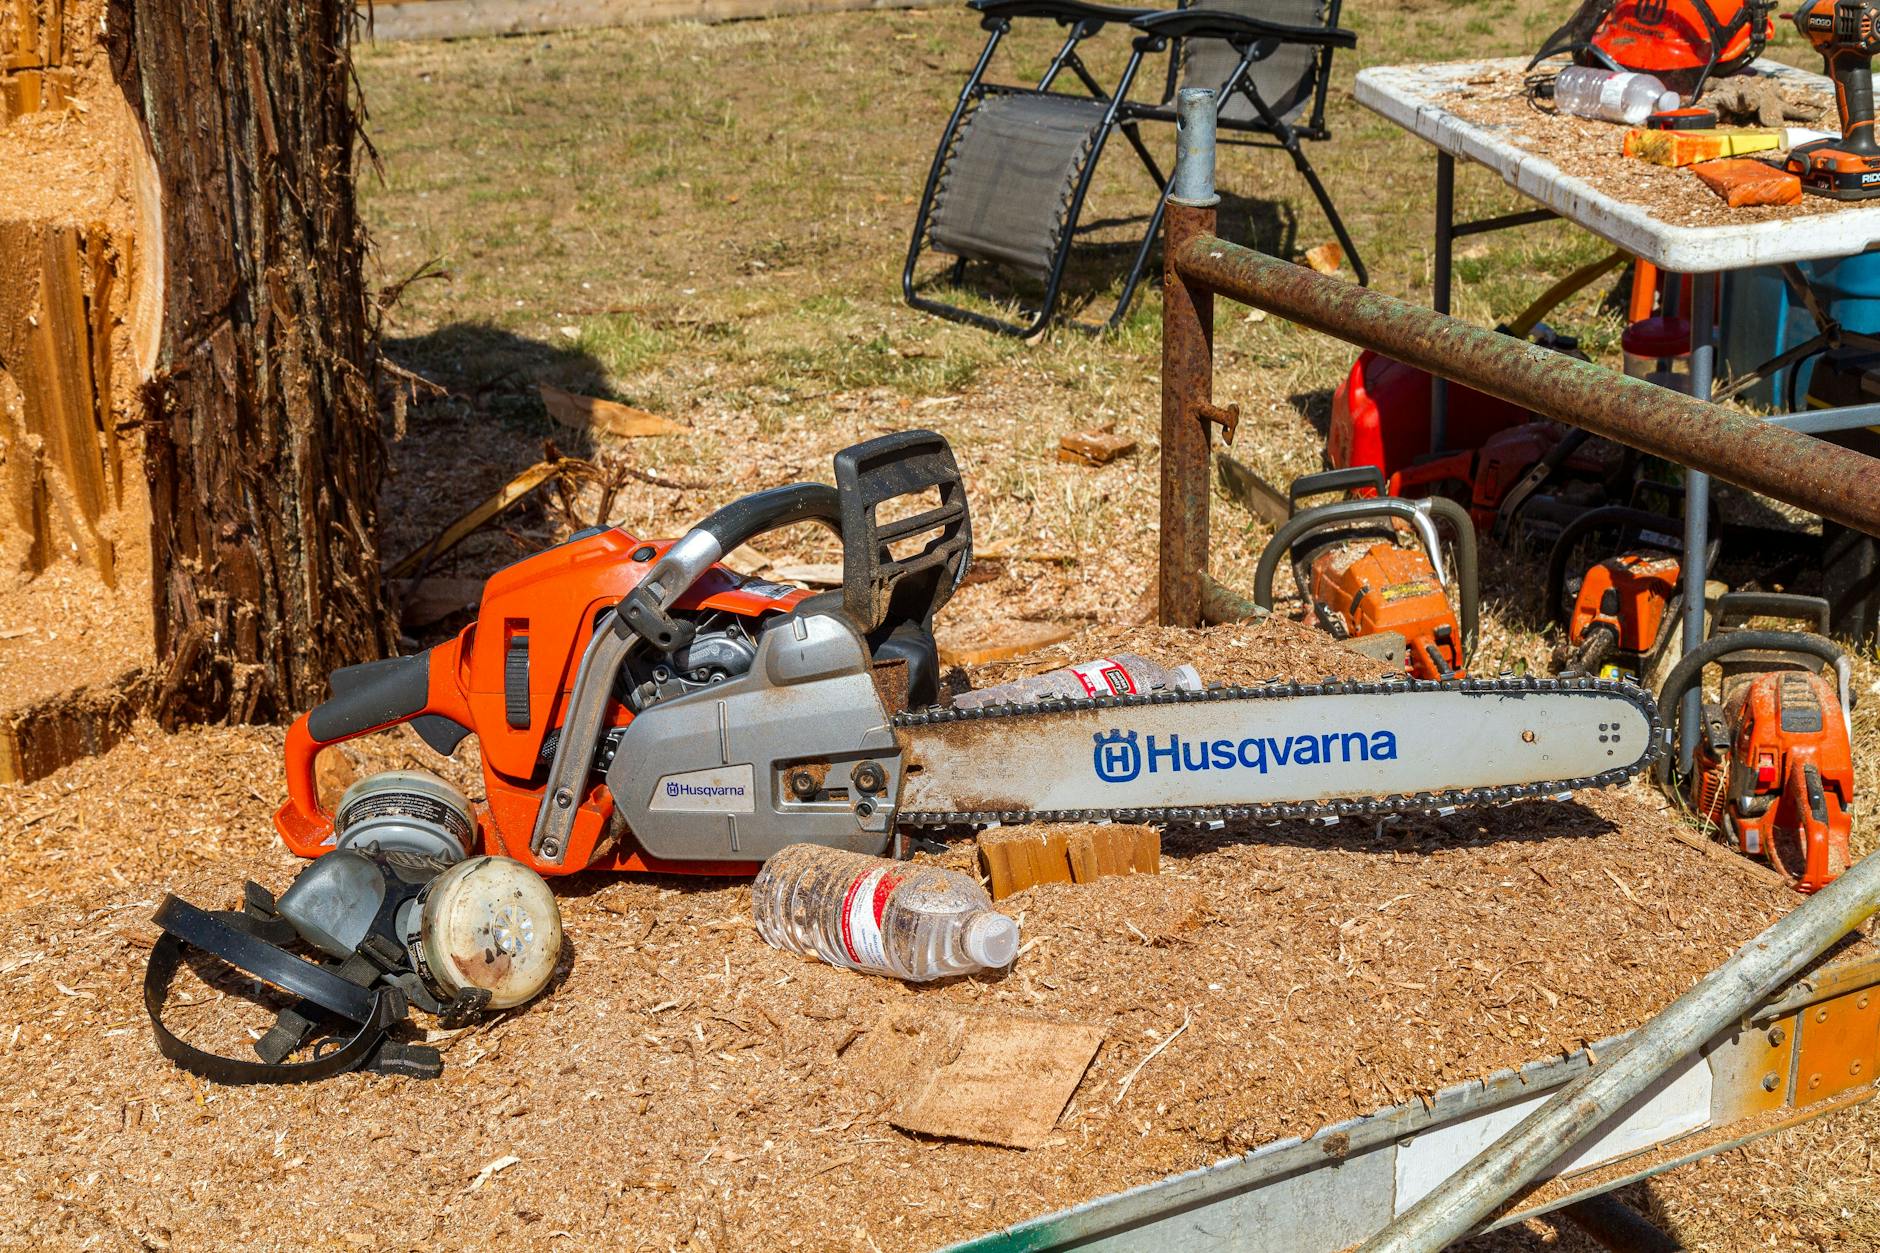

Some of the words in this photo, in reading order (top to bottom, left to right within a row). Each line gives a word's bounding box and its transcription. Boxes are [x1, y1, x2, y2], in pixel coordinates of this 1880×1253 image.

[1862, 173, 1880, 183] RID
[1146, 730, 1398, 774] Husqvarna
[680, 784, 744, 797] Husqvarna
